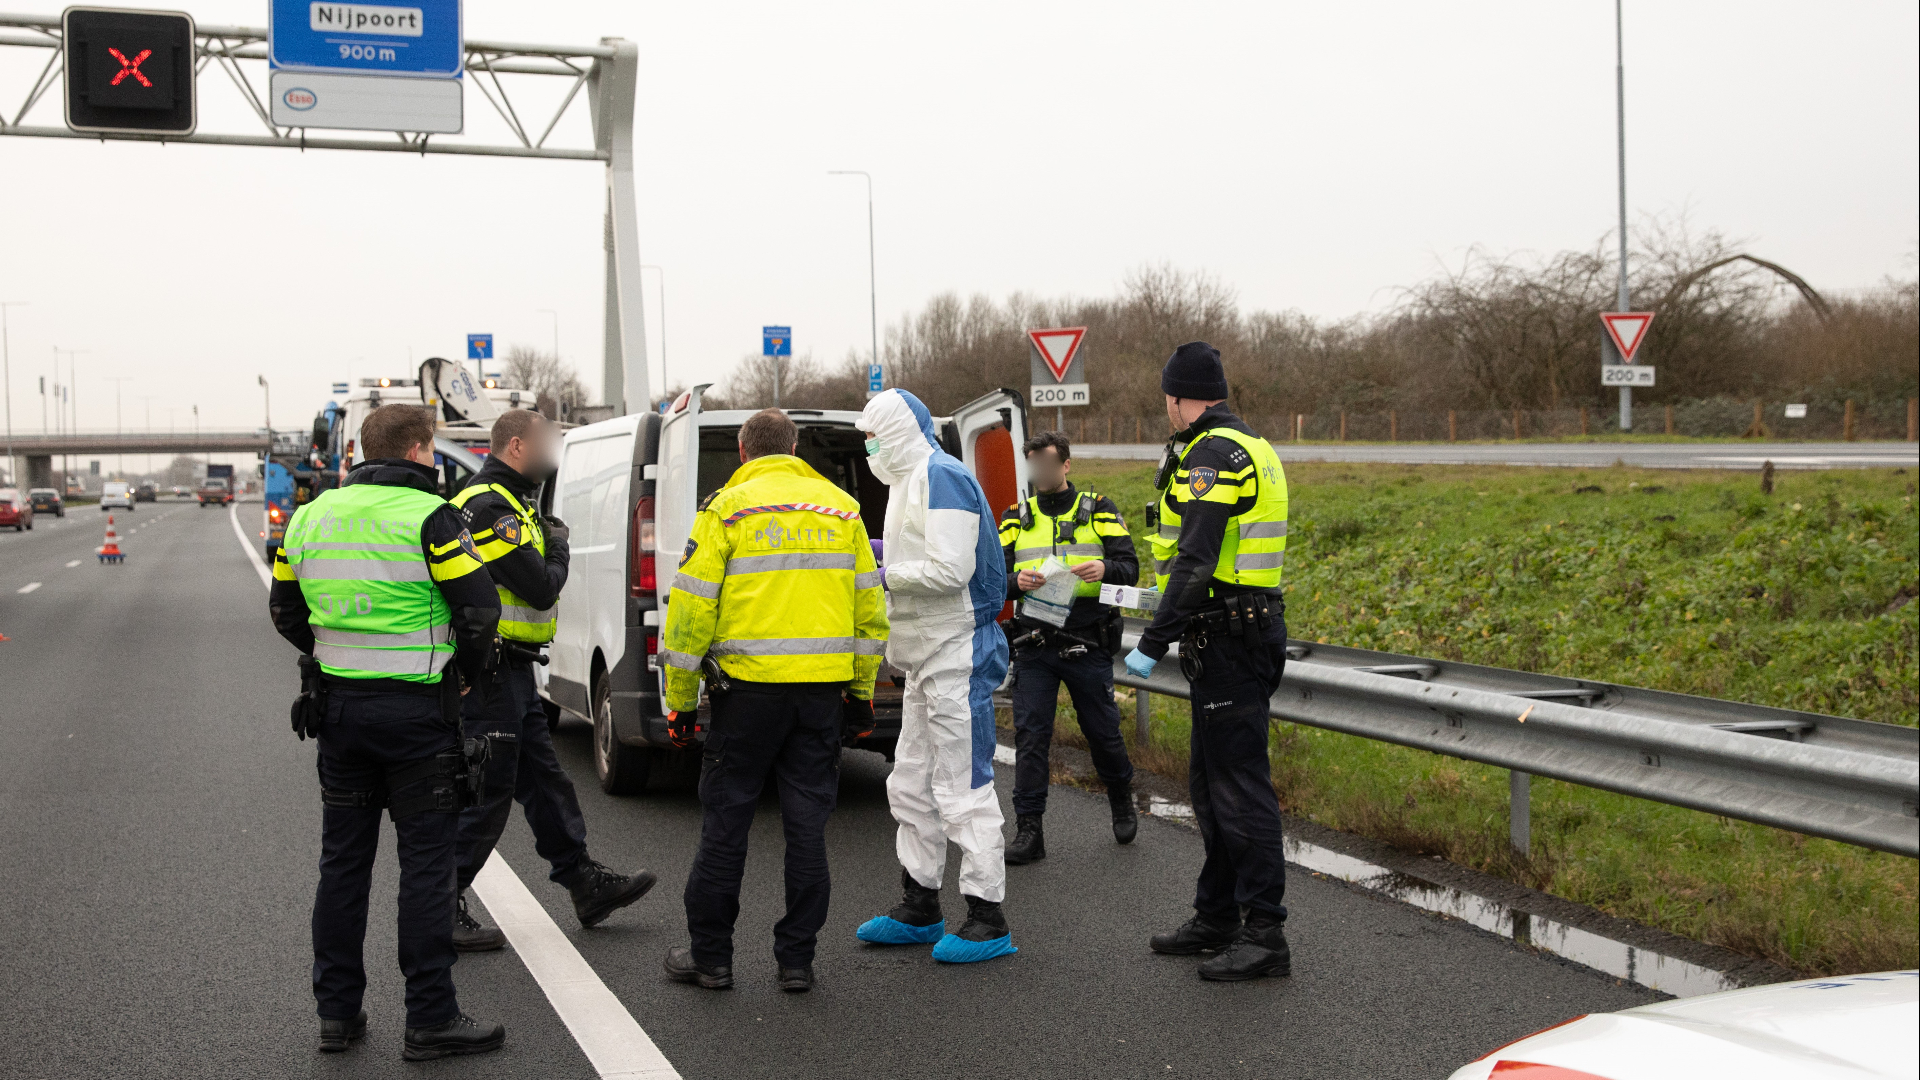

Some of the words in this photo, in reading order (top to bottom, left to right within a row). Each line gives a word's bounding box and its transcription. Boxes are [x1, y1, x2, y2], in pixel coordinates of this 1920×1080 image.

[318, 7, 417, 29] Nijpoort
[339, 45, 375, 60] 900
[379, 49, 396, 62] m
[289, 93, 313, 104] Esso
[1606, 369, 1635, 381] 200
[1639, 371, 1651, 381] m
[1035, 389, 1066, 402] 200
[1073, 391, 1085, 400] m
[308, 512, 390, 538] POLITIE
[755, 523, 836, 548] POLITIE
[319, 593, 373, 616] OvD
